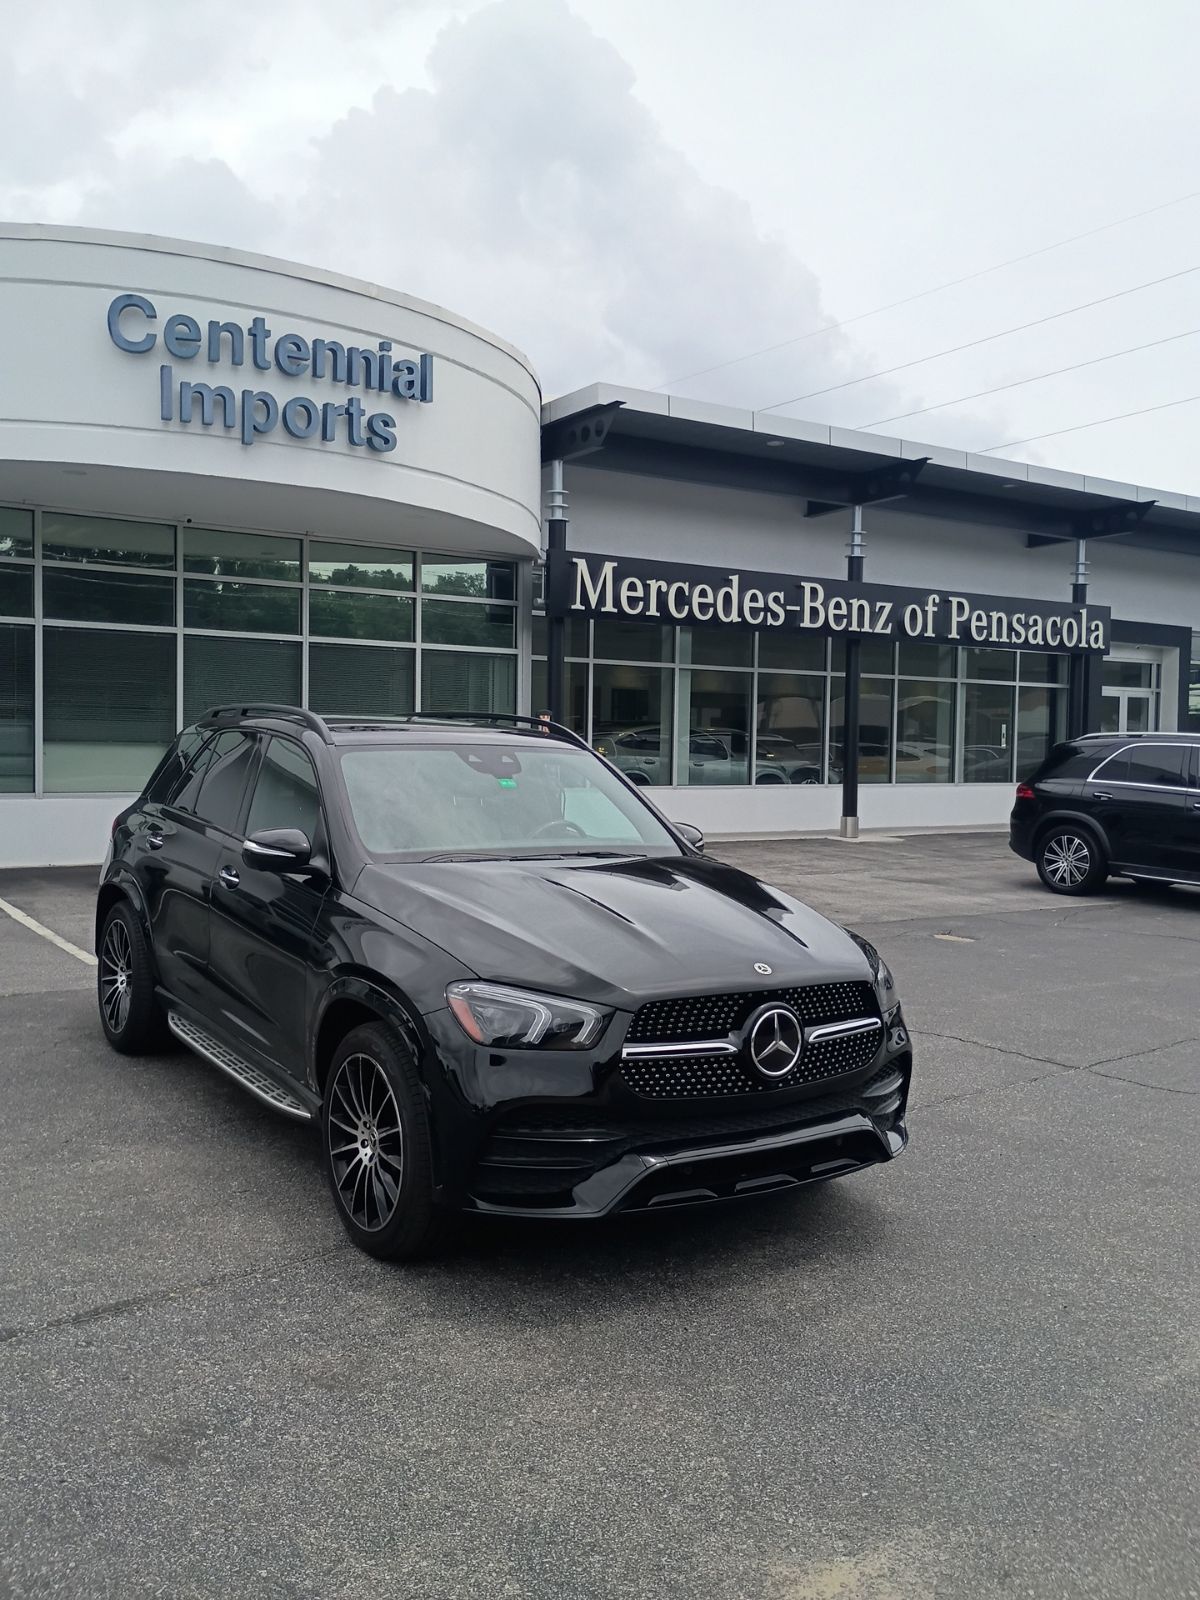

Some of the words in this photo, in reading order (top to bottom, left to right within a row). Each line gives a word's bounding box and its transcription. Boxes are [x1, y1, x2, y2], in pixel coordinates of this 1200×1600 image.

[107, 294, 433, 402] Centennial
[160, 365, 397, 452] Imports
[570, 557, 893, 634] Mercedes-Benz
[904, 594, 940, 637] of
[947, 596, 1105, 649] Pensacola
